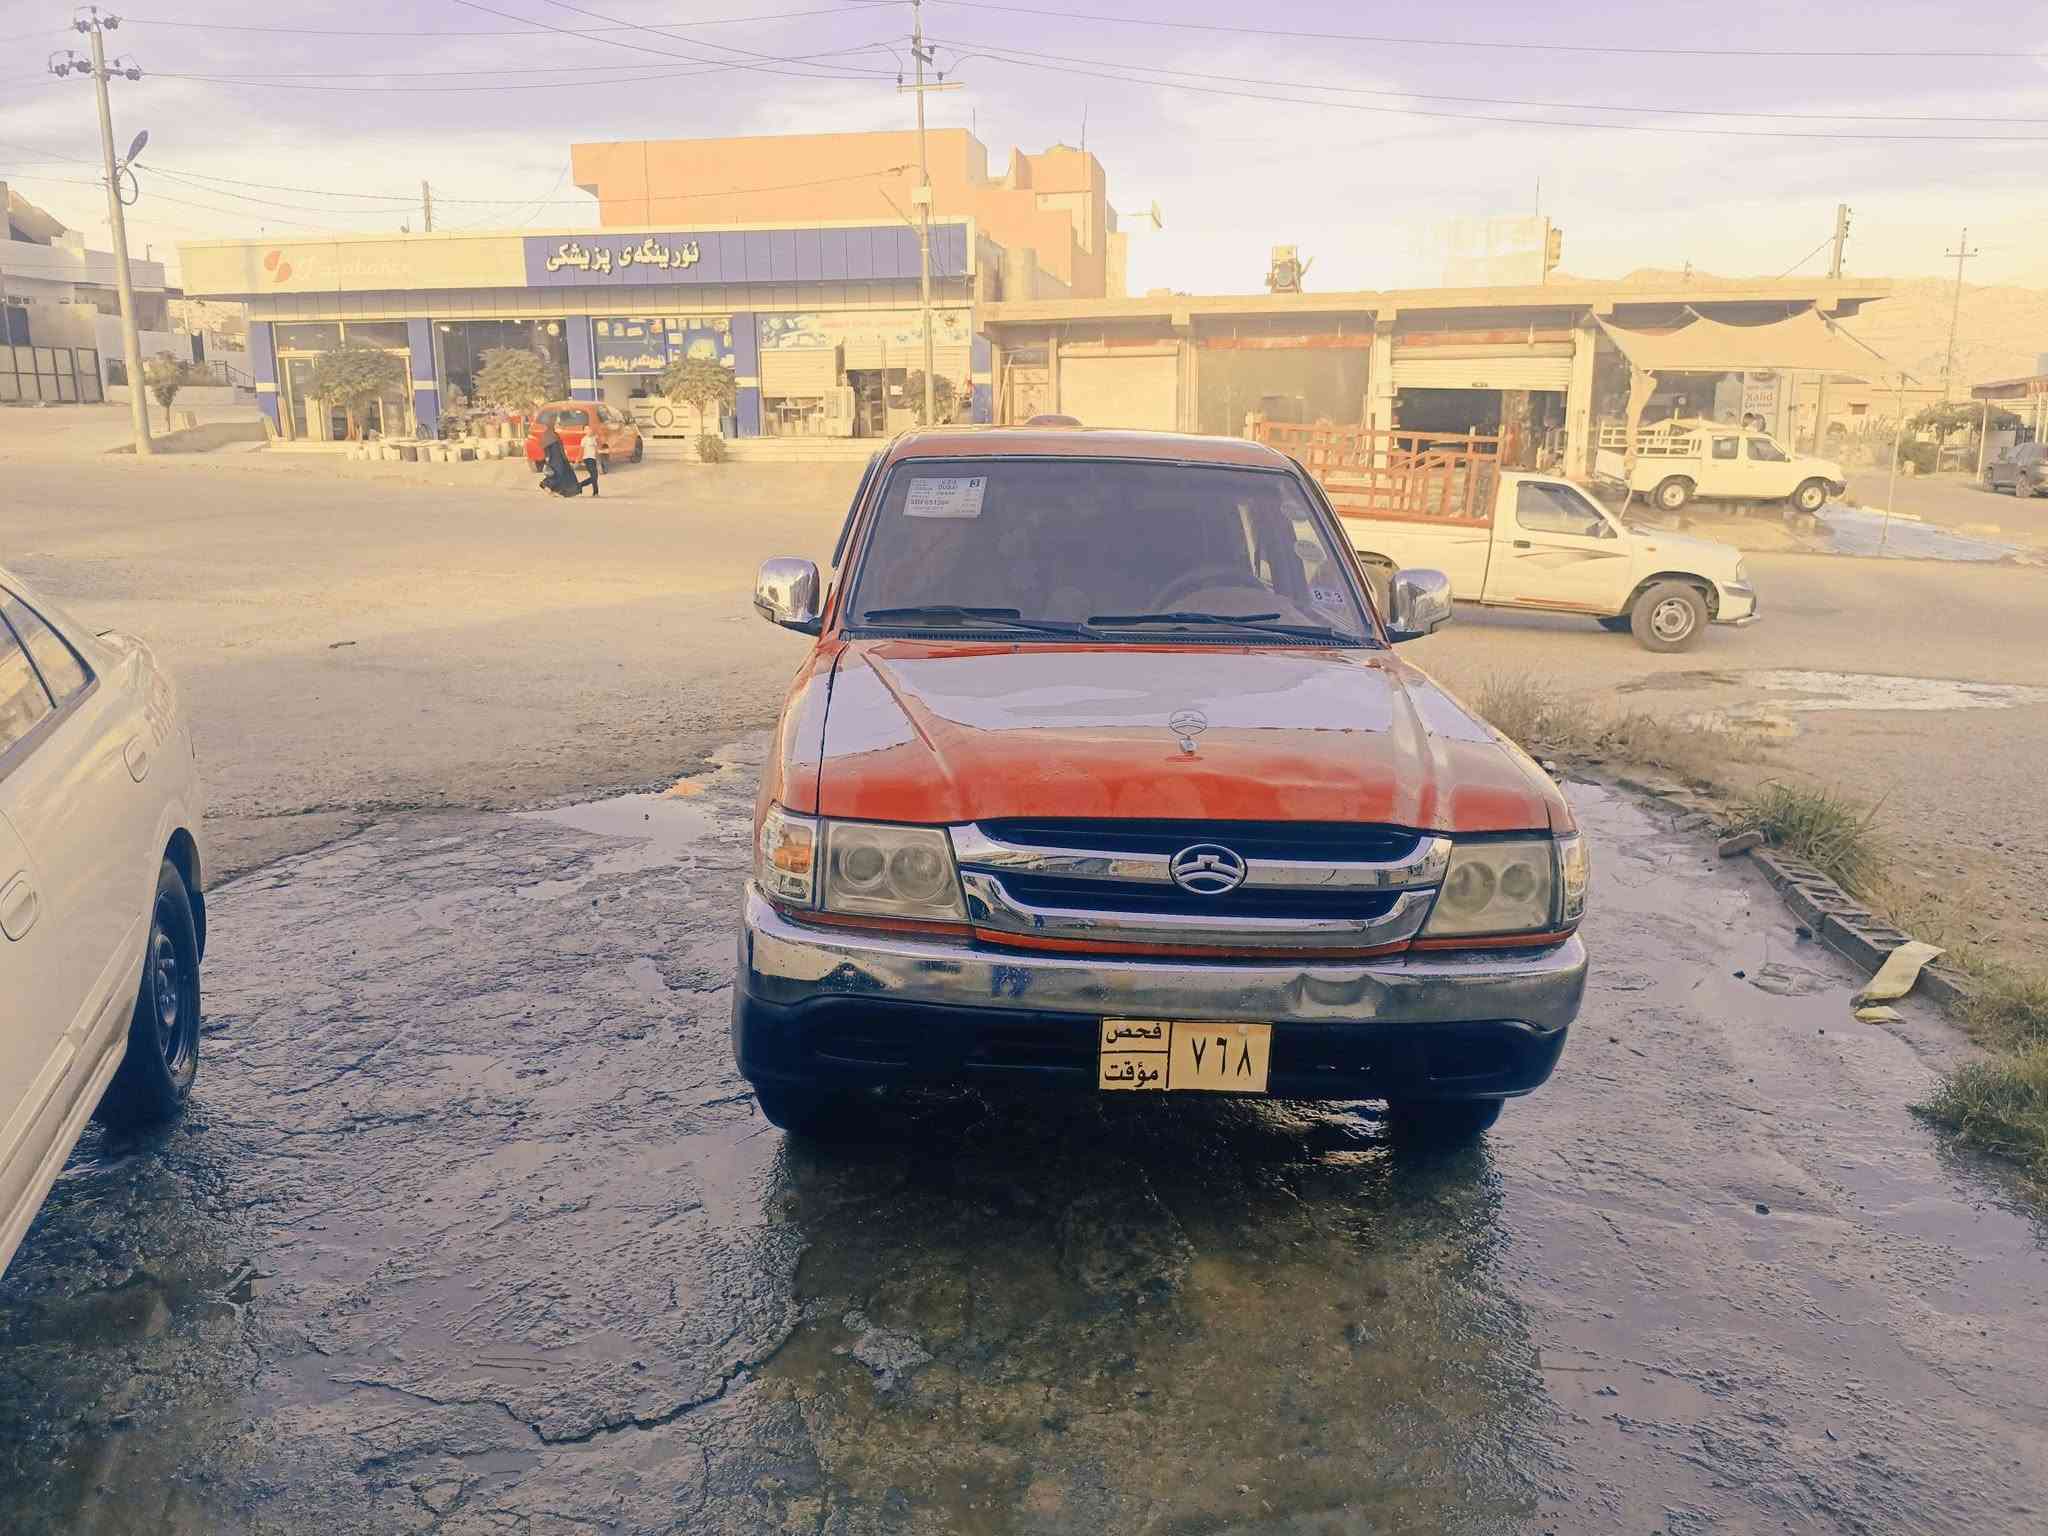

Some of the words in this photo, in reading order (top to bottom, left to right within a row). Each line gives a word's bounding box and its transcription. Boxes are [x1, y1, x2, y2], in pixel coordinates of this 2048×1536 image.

[546, 243, 612, 275] پزیشکی
[1105, 1022, 1162, 1044] فحص
[1191, 1036, 1252, 1078] ٧٦٨
[1104, 1060, 1160, 1088] مؤقت
